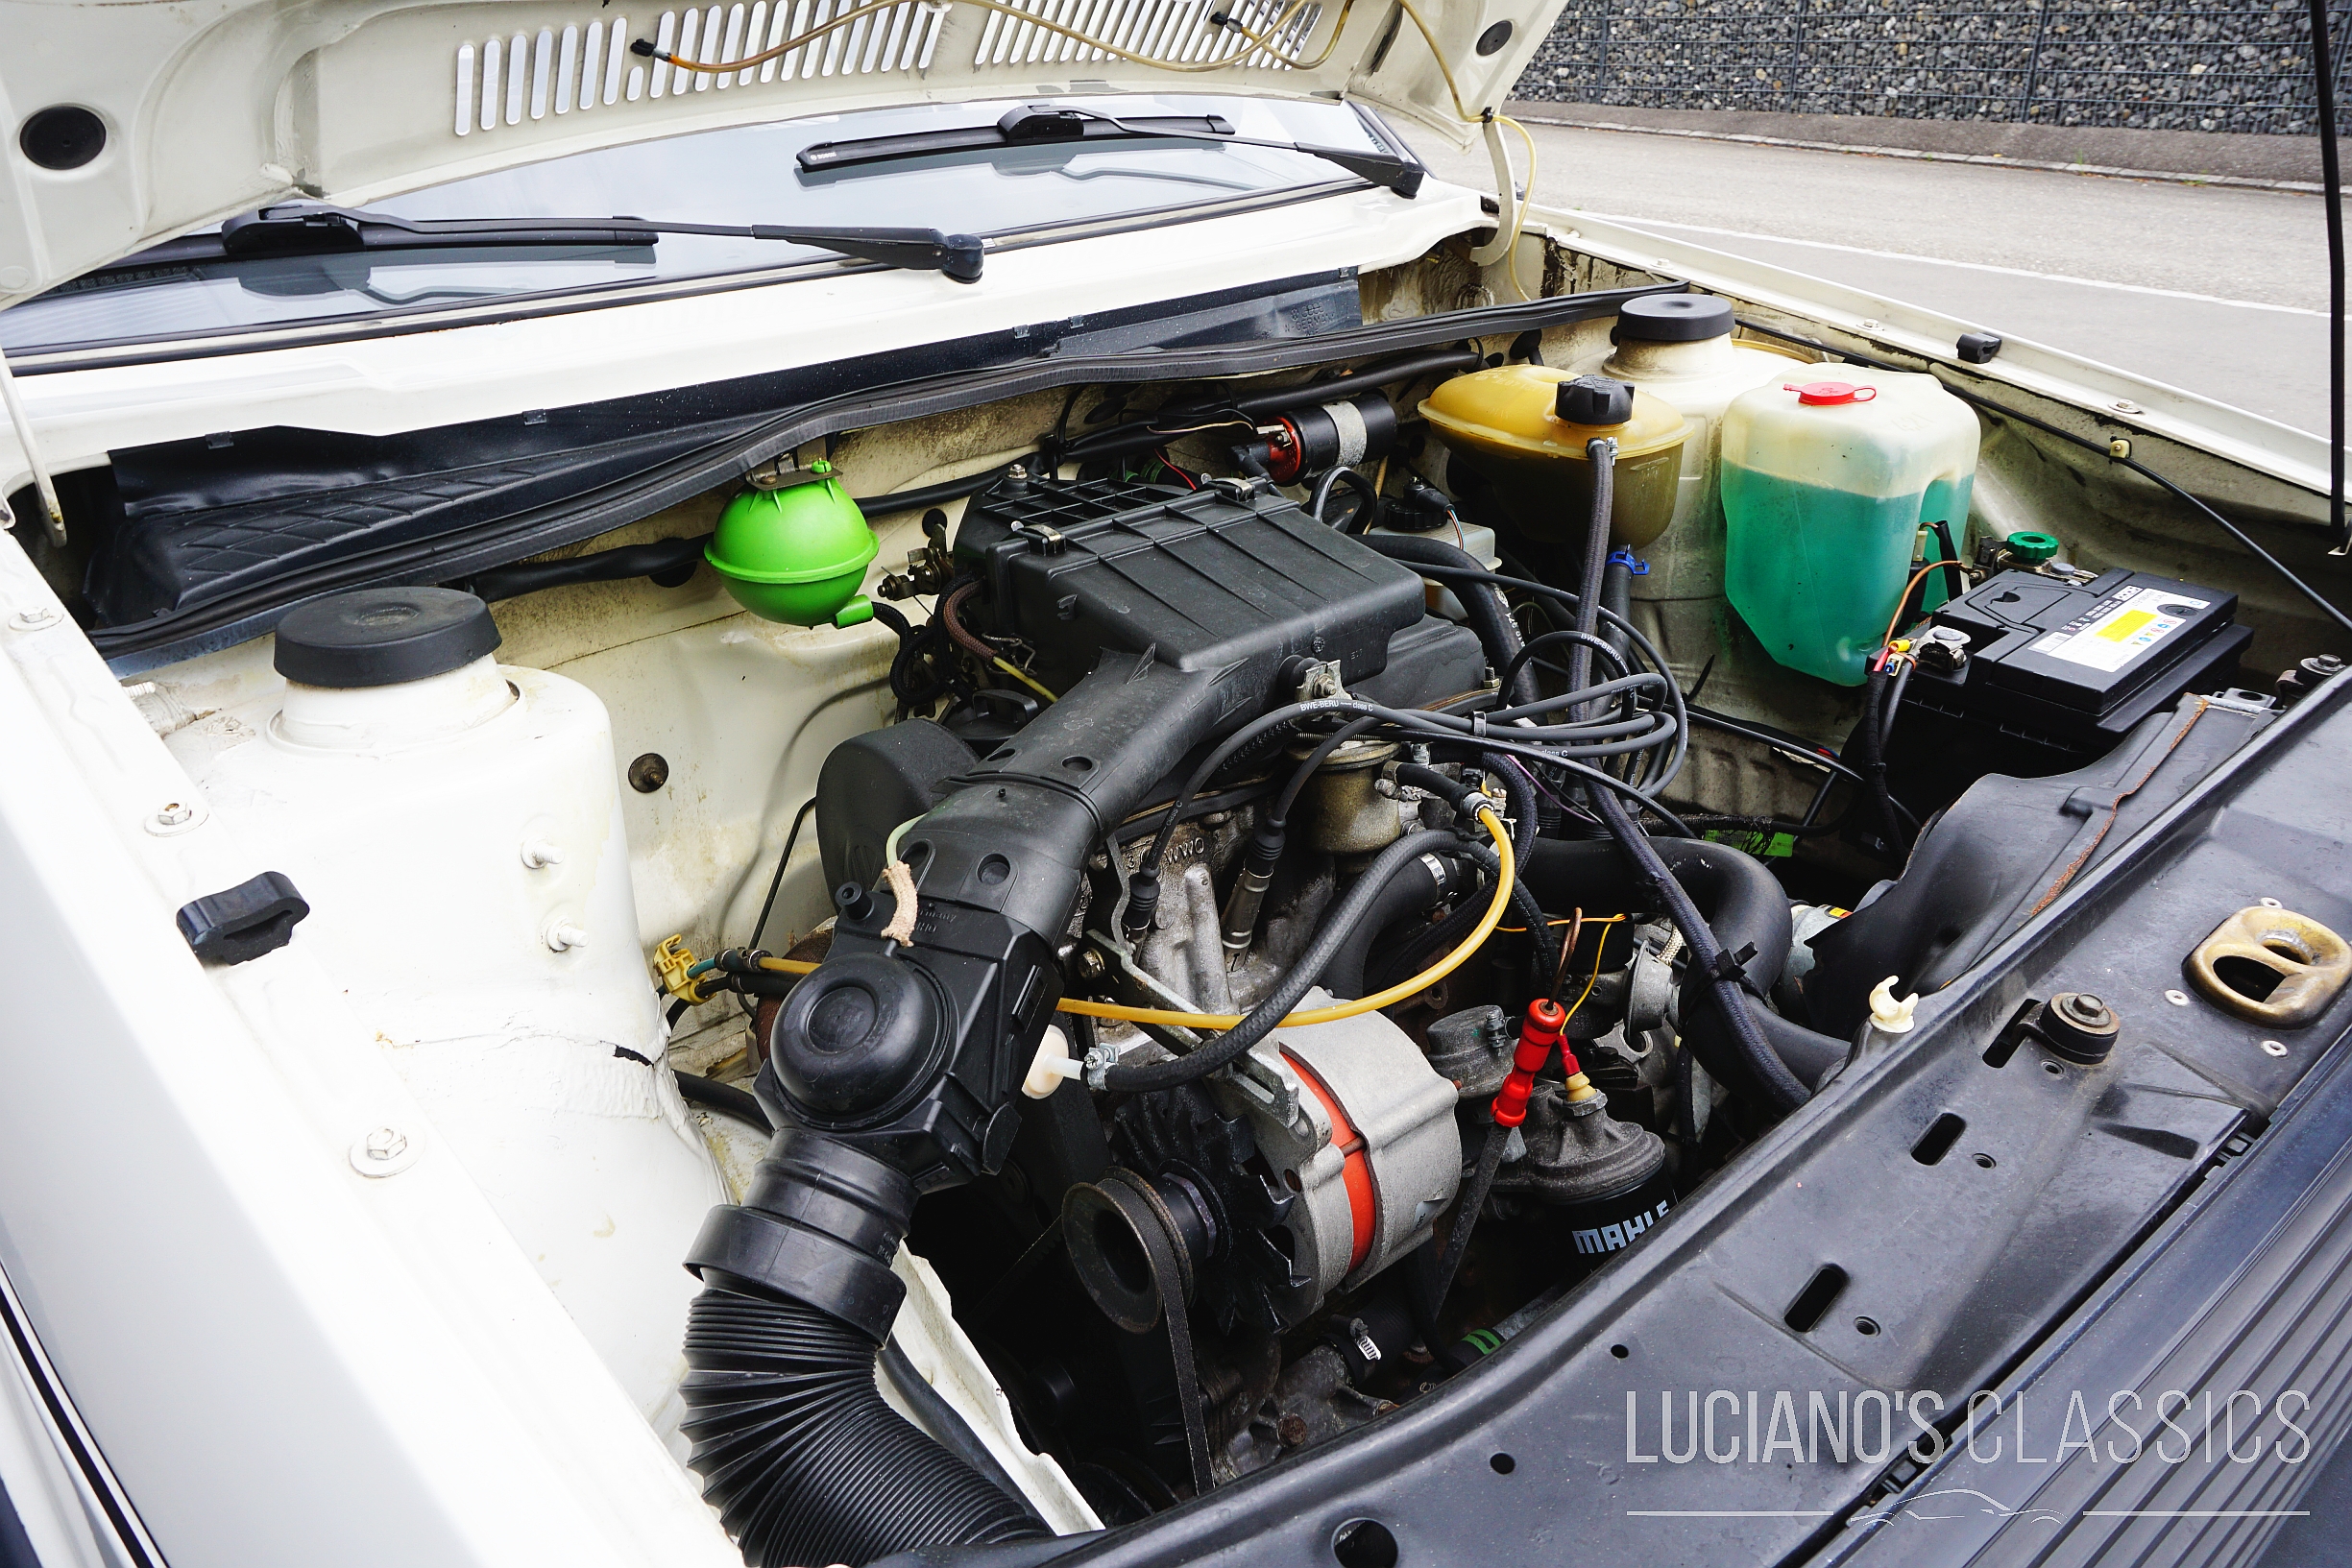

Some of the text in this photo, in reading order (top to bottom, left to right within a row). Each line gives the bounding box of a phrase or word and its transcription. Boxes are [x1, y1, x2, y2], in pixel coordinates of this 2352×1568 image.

[1580, 633, 1621, 661] BWE-BERU
[1299, 699, 1340, 712] BWE-BERU
[1352, 701, 1368, 711] class
